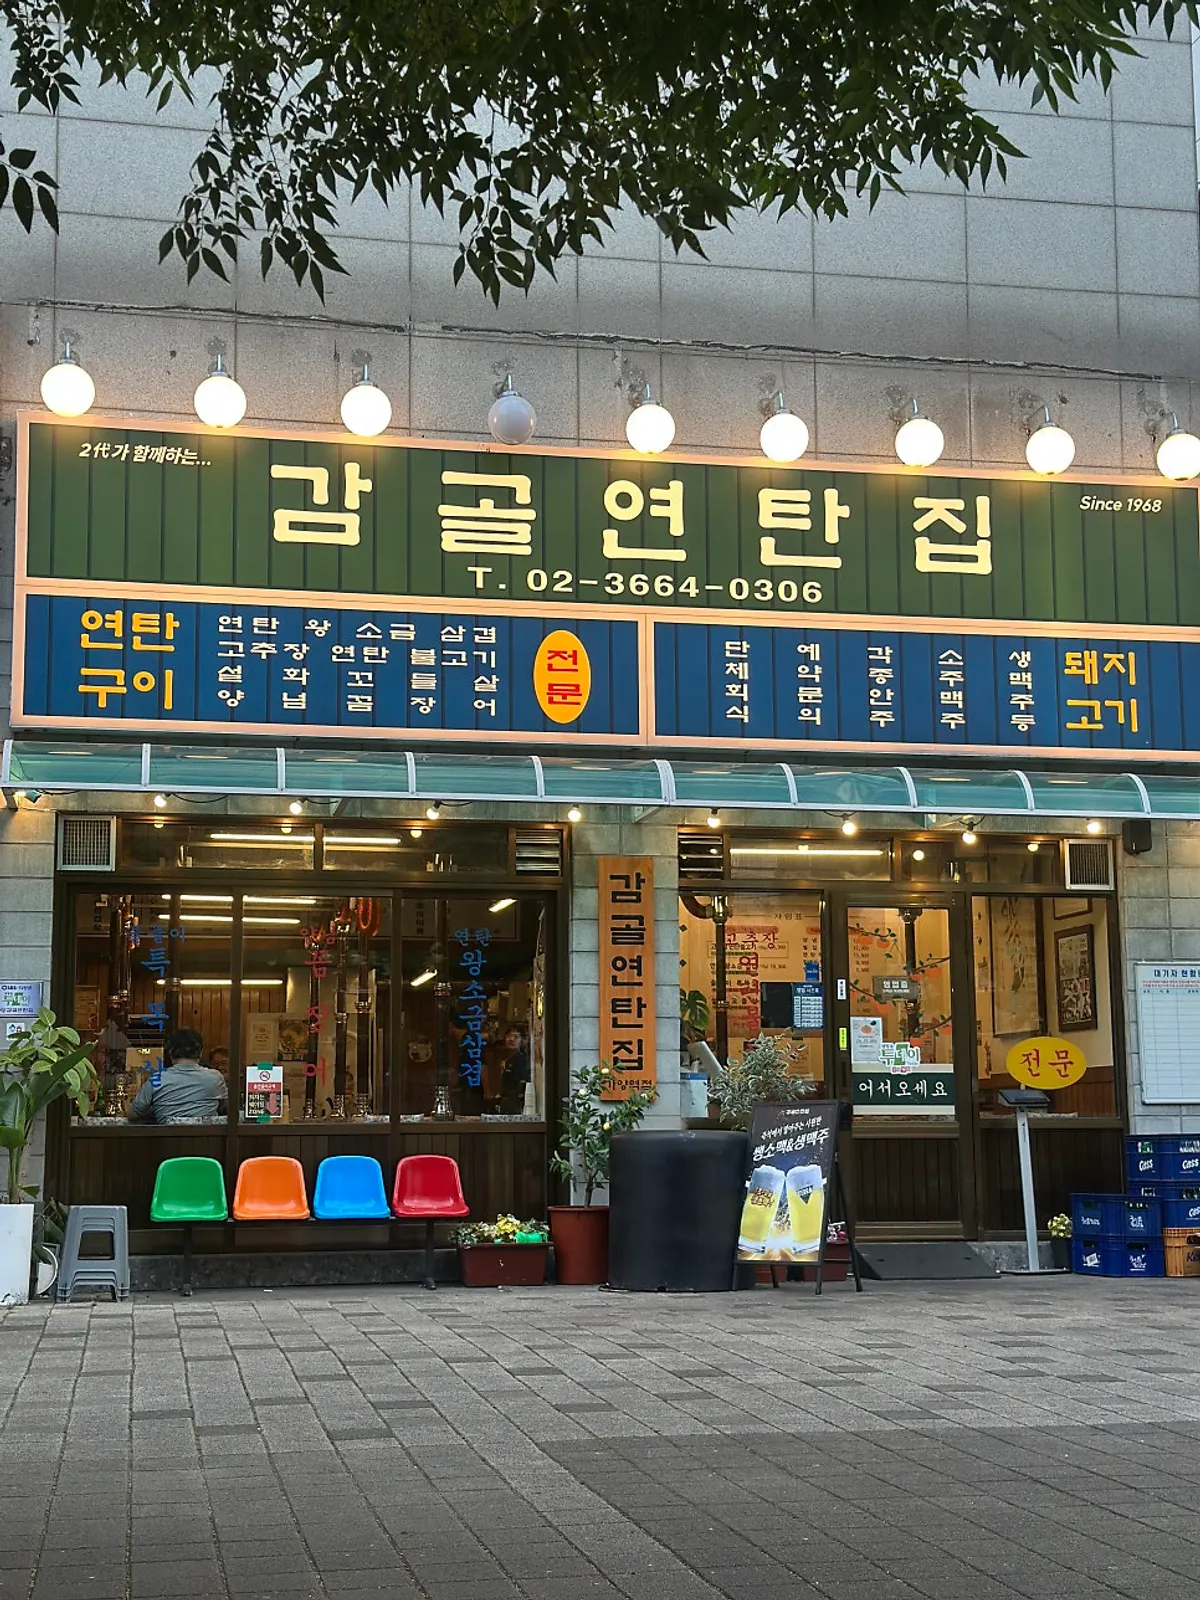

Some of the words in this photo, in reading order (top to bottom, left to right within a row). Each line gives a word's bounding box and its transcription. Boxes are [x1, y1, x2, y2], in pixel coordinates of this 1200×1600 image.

[270, 461, 992, 575] 감골연탄집
[1079, 495, 1123, 512] Since
[1126, 497, 1162, 513] 1968
[468, 566, 506, 590] T.
[526, 567, 824, 604] 02-3664-0306
[80, 609, 179, 653] 연탄
[218, 614, 280, 635] 연탄
[304, 618, 332, 638] 왕
[355, 622, 417, 642] 소금
[440, 625, 497, 644] 삼겹
[217, 640, 310, 661] 고추장
[331, 645, 390, 664] 연탄
[410, 648, 496, 669] 불고기
[1063, 651, 1137, 687] 돼지
[78, 667, 173, 710] 구이
[546, 649, 583, 706] 전문
[725, 640, 751, 724] 단체회식
[796, 643, 824, 726] 예약문의
[867, 645, 896, 728] 각종안주
[937, 649, 966, 730] 소주맥주
[1008, 650, 1036, 732] 생맥주등
[1065, 698, 1139, 733] 고기
[609, 872, 647, 1071] 감골연탄집
[1154, 969, 1177, 977] 대기자
[1181, 969, 1200, 977] 현황
[459, 950, 487, 1088] 왕소금삼겹
[1018, 1047, 1075, 1078] 전문
[858, 1079, 948, 1099] 어서오세요
[1138, 1158, 1154, 1172] Cass
[1182, 1157, 1199, 1170] Cass
